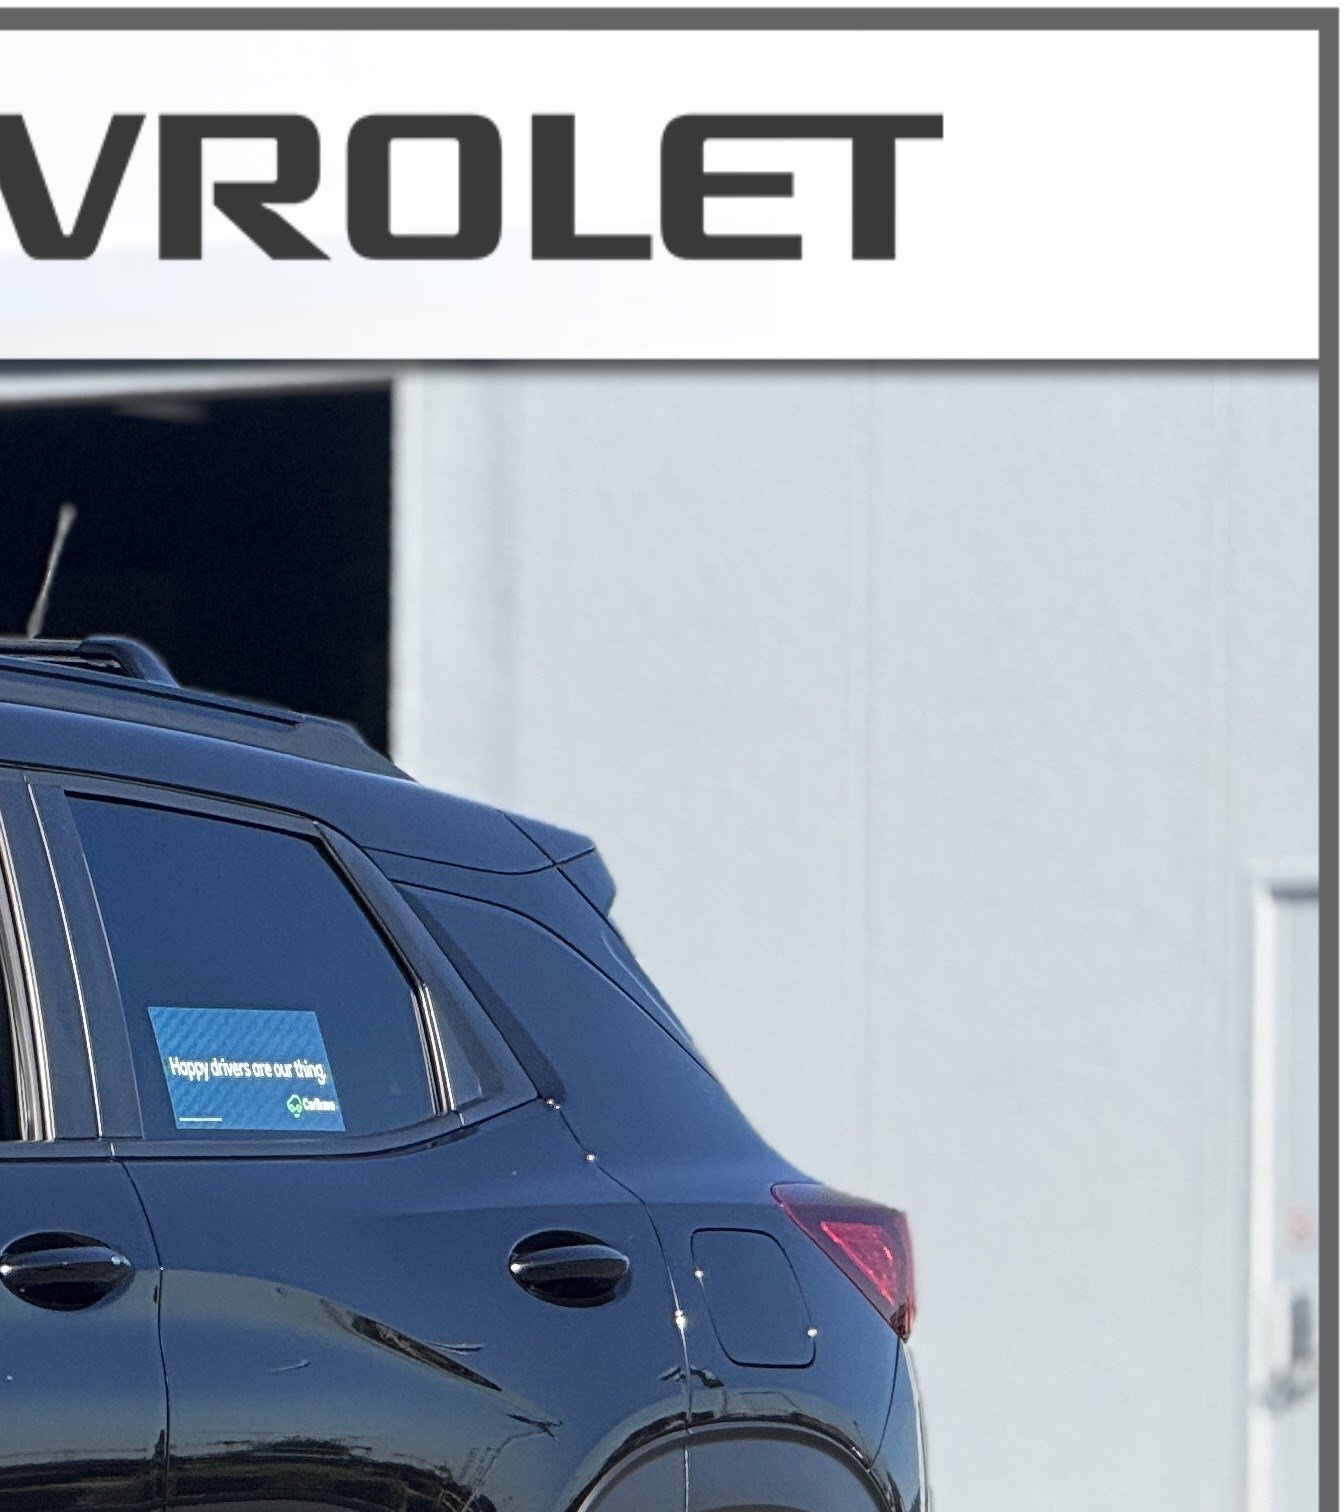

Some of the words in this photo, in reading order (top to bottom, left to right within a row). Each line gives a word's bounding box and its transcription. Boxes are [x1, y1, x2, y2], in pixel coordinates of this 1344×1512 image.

[168, 1056, 210, 1082] Happy
[210, 1057, 252, 1078] drivers
[252, 1061, 273, 1078] are
[273, 1062, 293, 1078] our
